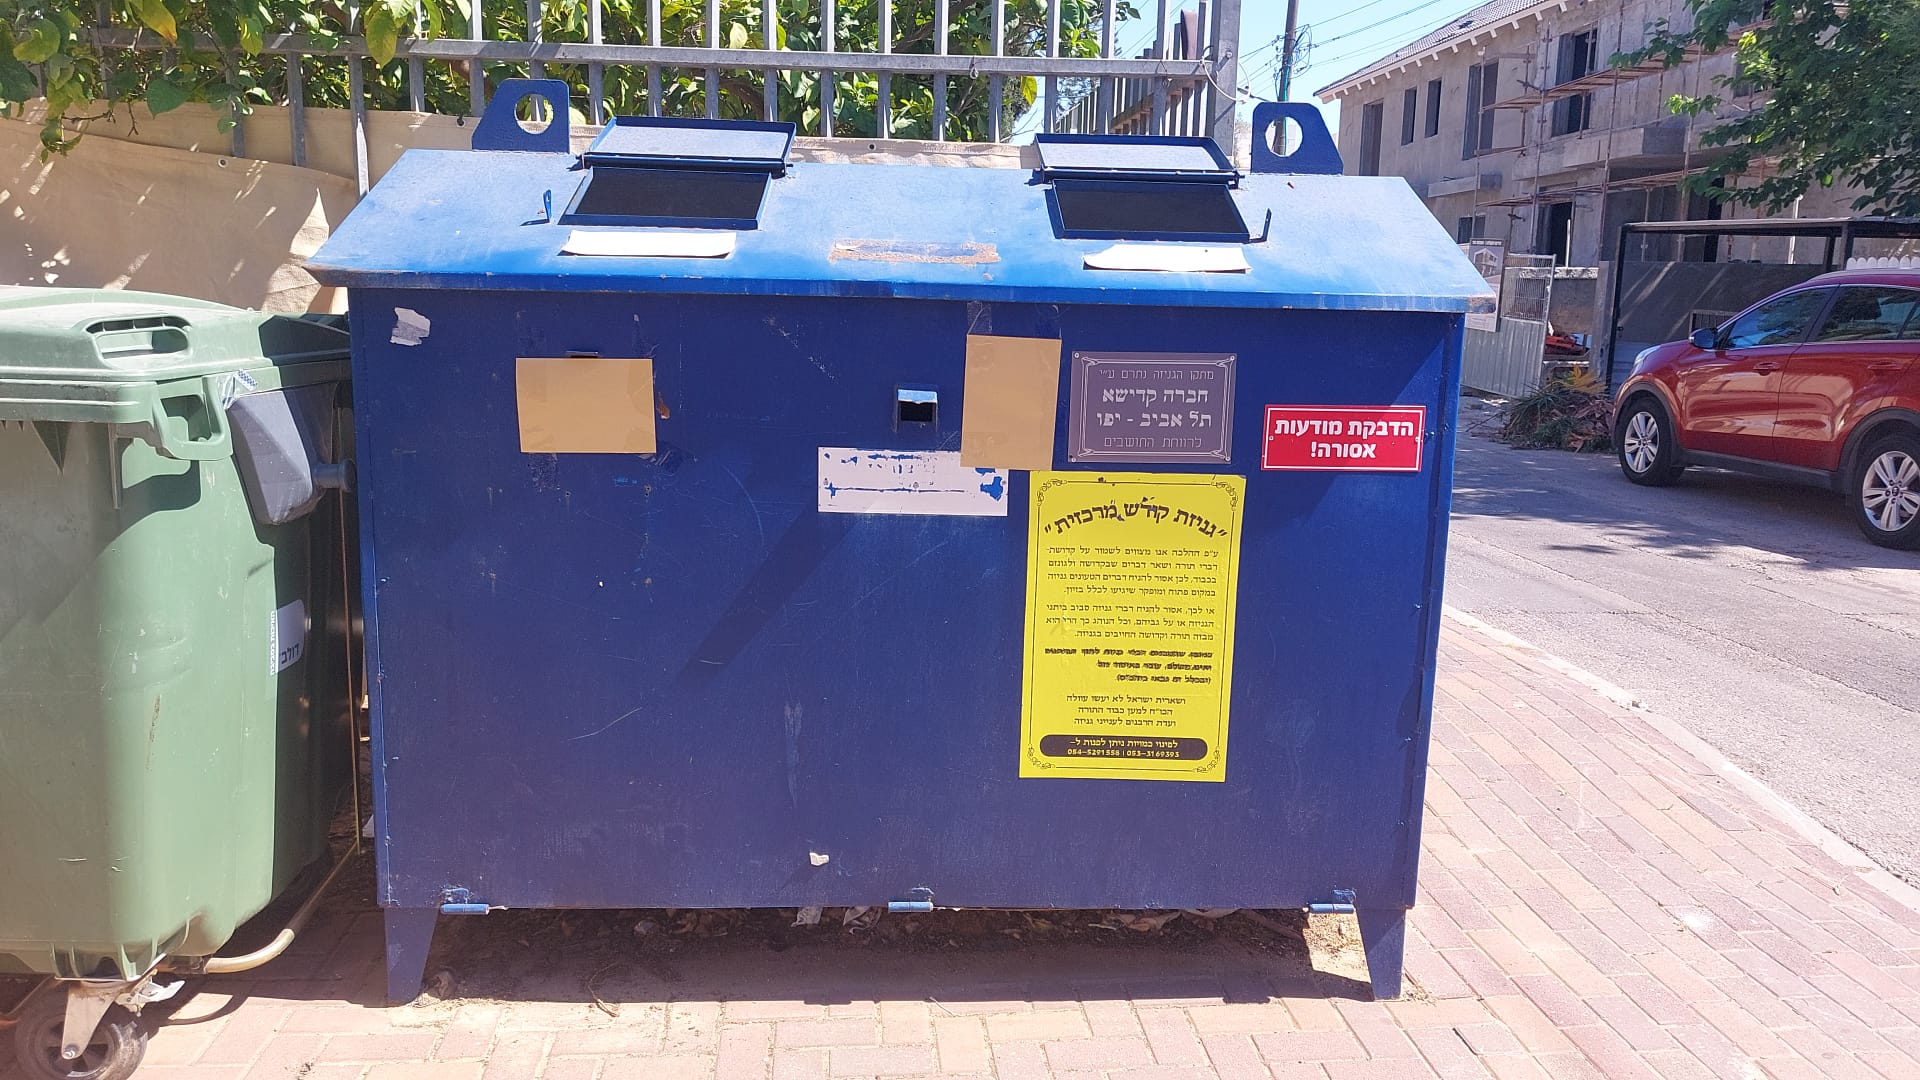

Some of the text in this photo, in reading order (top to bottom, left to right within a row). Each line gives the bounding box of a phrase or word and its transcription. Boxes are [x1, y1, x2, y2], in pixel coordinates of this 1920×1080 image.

[1121, 370, 1147, 379] נתרם
[1154, 371, 1182, 379] הגניזה
[1190, 371, 1213, 380] מתקן
[1103, 389, 1208, 407] חברה קדישא
[1097, 413, 1120, 426] יפו
[1140, 413, 1182, 427] אביב
[1190, 411, 1211, 427] תל
[1275, 420, 1413, 440] הדבקת מודעות
[1104, 437, 1202, 448] לרווחת התושבים
[1311, 442, 1376, 458] אסורה!
[1080, 545, 1090, 554] על
[1095, 546, 1120, 554] לשמור
[1125, 547, 1150, 555] מצווים
[1172, 548, 1200, 556] ההלכה
[1080, 561, 1117, 569] שבקדושה
[1129, 573, 1152, 581] להניח
[1176, 574, 1188, 584] לכן
[1087, 585, 1107, 593] לכלל
[1139, 587, 1165, 596] ומופקר
[1192, 590, 1215, 598] במקום
[1137, 604, 1160, 612] להניח
[1080, 618, 1089, 626] כך
[1118, 616, 1130, 624] וכל
[1163, 618, 1173, 626] על
[1188, 620, 1214, 628] הגניזה
[1139, 632, 1167, 640] וקדושה
[1170, 632, 1190, 640] תורה
[281, 643, 299, 664] דולב
[1067, 693, 1088, 702] עוולה
[1113, 694, 1123, 702] לא
[1127, 695, 1152, 703] ישראל
[1156, 696, 1185, 704] ושארית
[1128, 706, 1147, 716] למען
[1097, 717, 1123, 725] לענייני
[1156, 719, 1176, 727] ועדת
[1083, 738, 1106, 746] לפנות
[1109, 740, 1124, 748] ניתן
[1156, 739, 1178, 747] לפינוי
